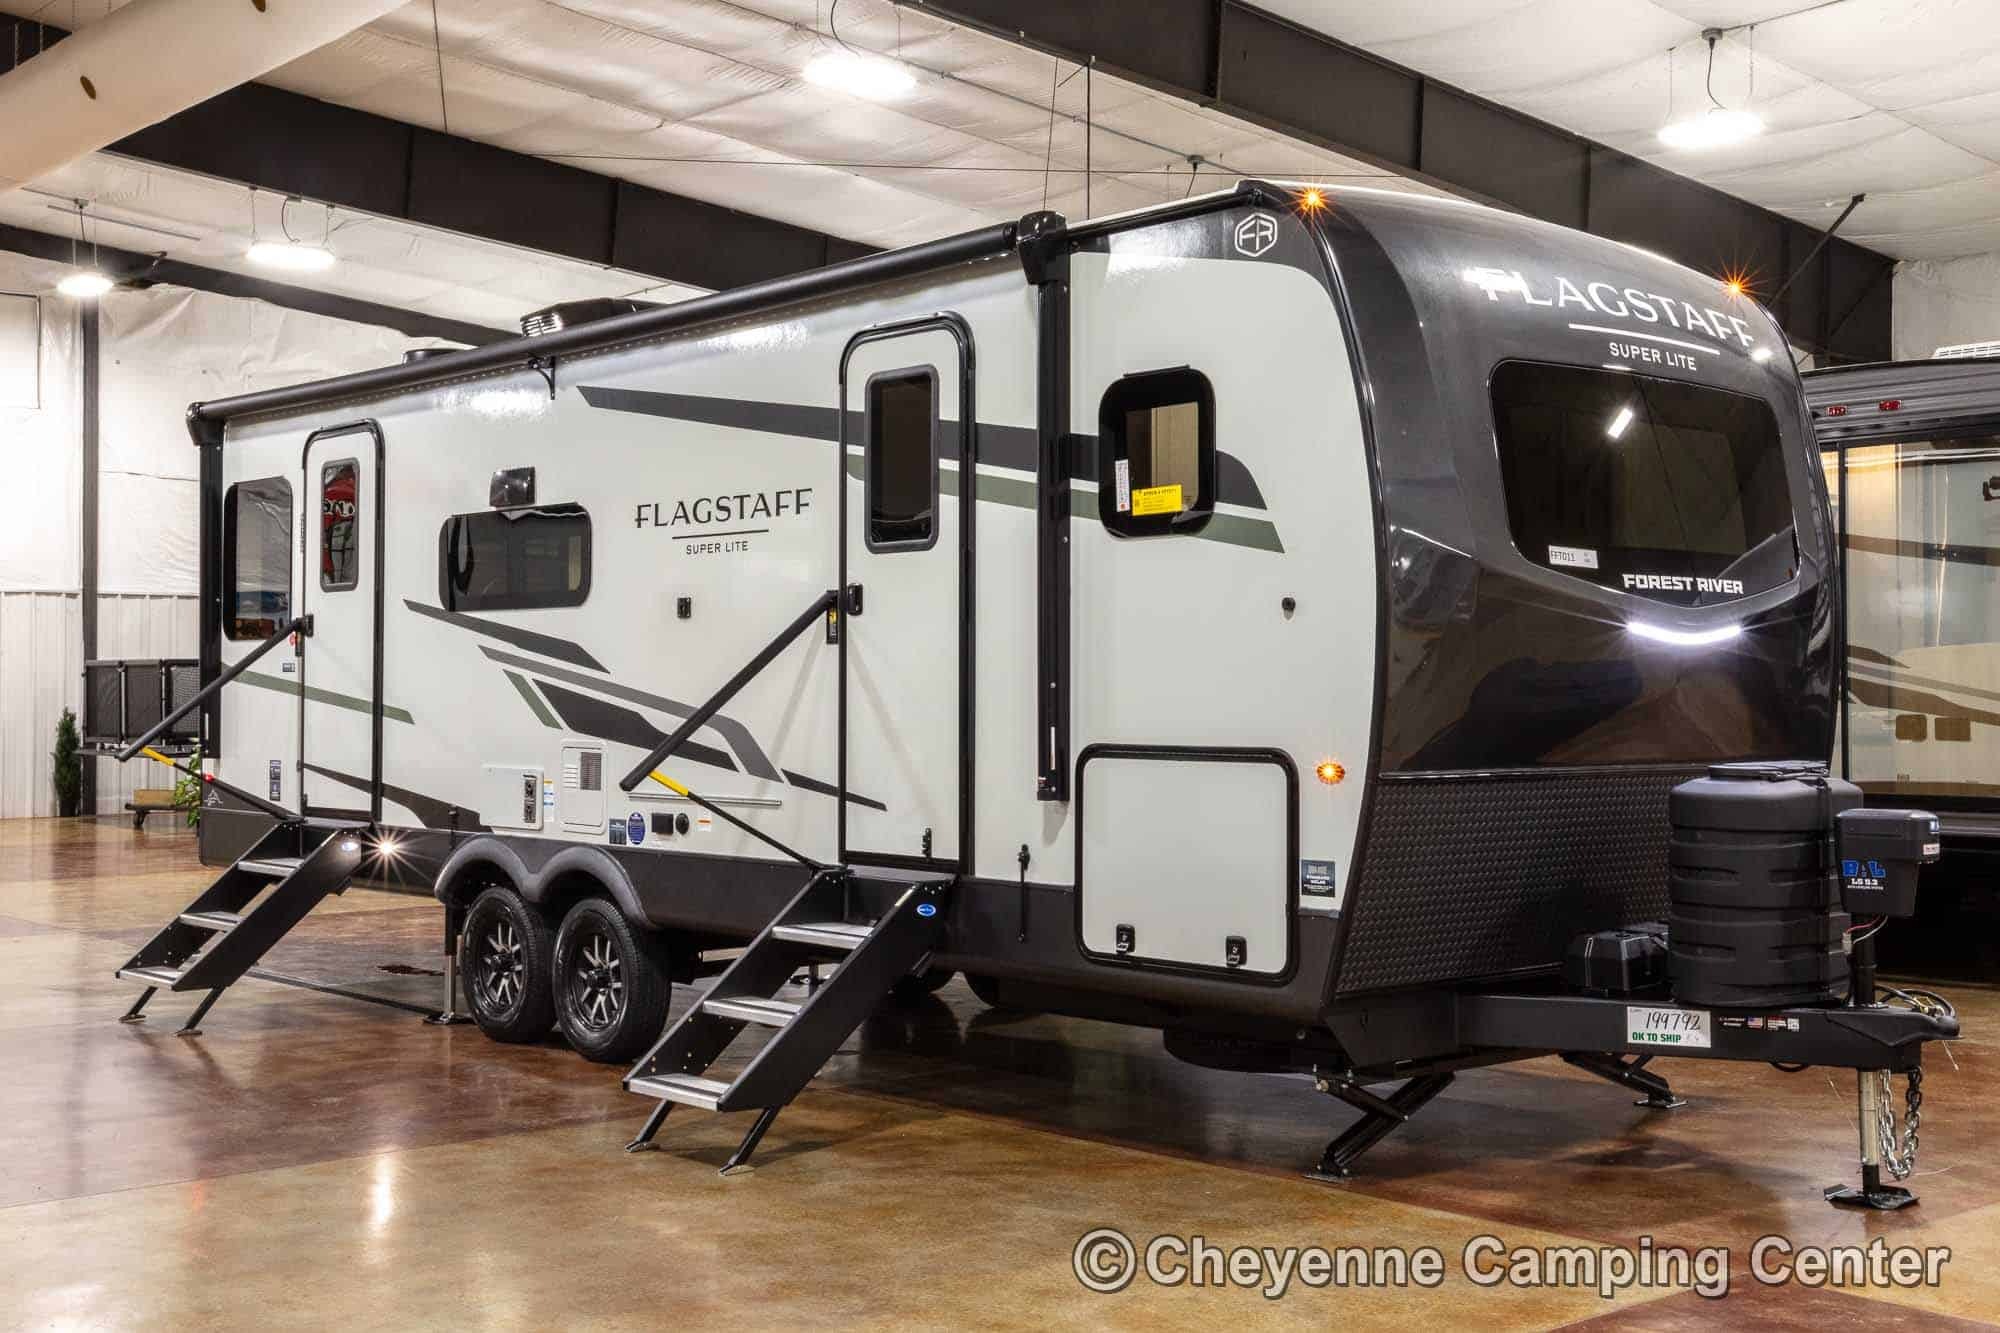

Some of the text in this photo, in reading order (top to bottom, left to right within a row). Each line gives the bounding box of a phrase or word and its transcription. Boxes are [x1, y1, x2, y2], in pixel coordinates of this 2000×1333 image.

[1472, 266, 1755, 347] FLAGSTAFF
[1608, 341, 1698, 372] SUPER LITE
[634, 487, 813, 529] FLAGSTAFF
[685, 540, 749, 556] SUPER LITE
[1621, 572, 1745, 595] FOREST RIVER
[1645, 1011, 1701, 1031] 199792
[1632, 1031, 1682, 1044] OK TO SHIP
